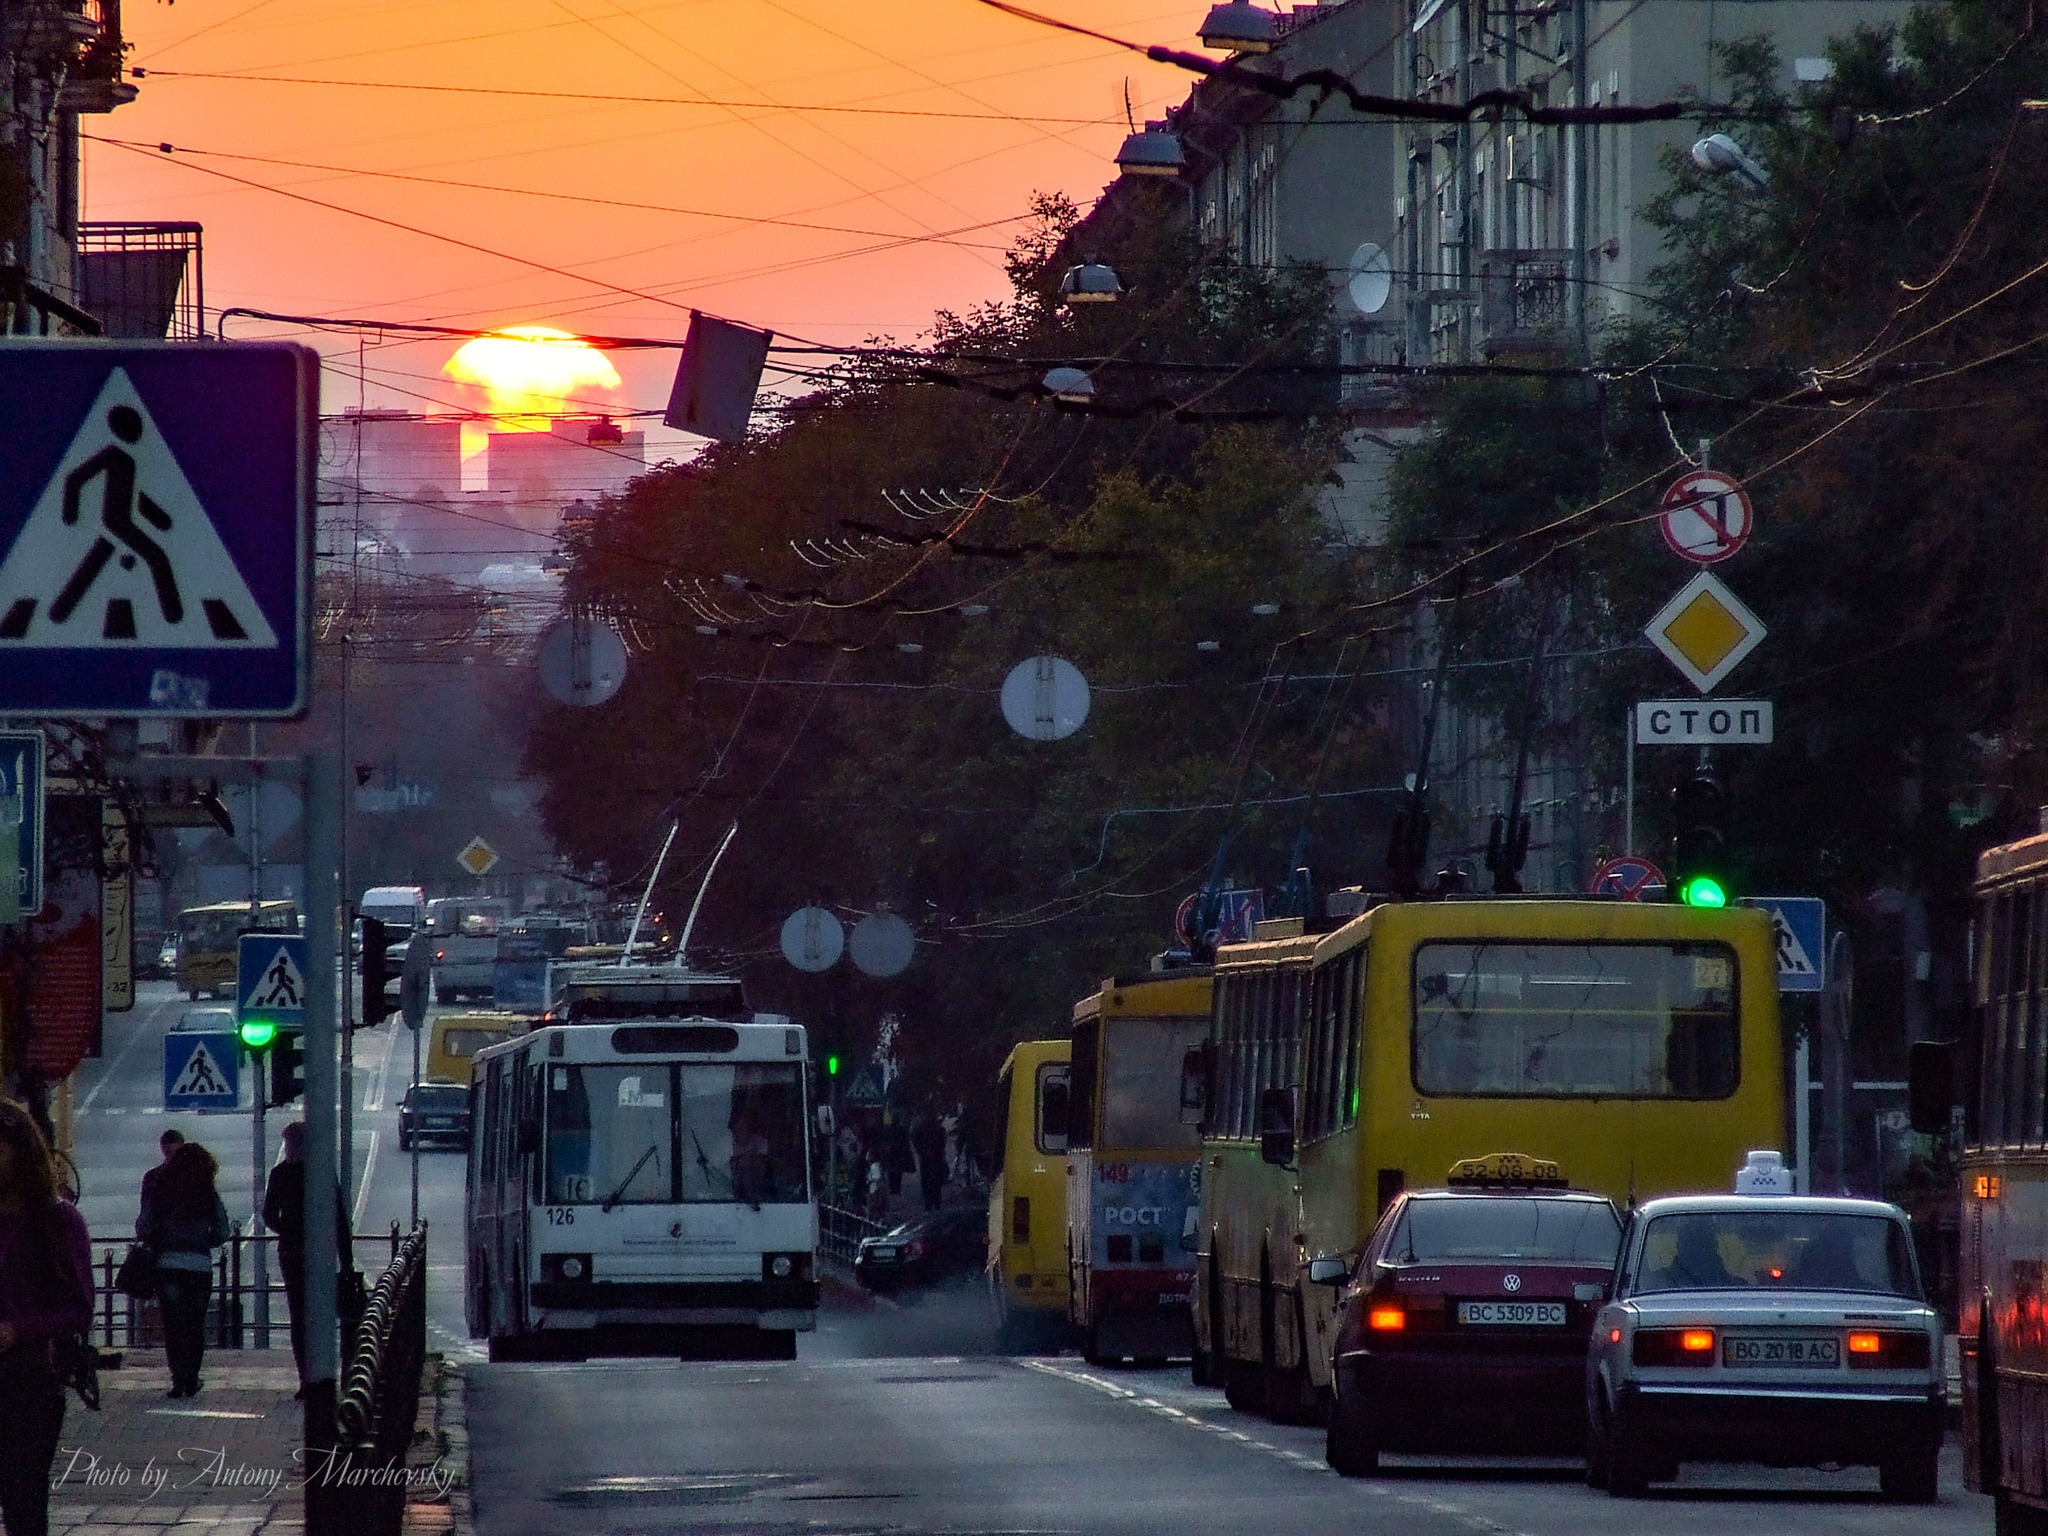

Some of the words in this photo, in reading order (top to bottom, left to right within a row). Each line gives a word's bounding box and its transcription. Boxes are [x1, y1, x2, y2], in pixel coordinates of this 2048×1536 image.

[1650, 709, 1760, 735] СТОП
[546, 1207, 575, 1226] 126
[1469, 1304, 1492, 1321] BC
[1496, 1304, 1534, 1321] 5309
[1537, 1305, 1561, 1322] BC
[1765, 1342, 1803, 1359] 2018
[1809, 1342, 1833, 1359] AC
